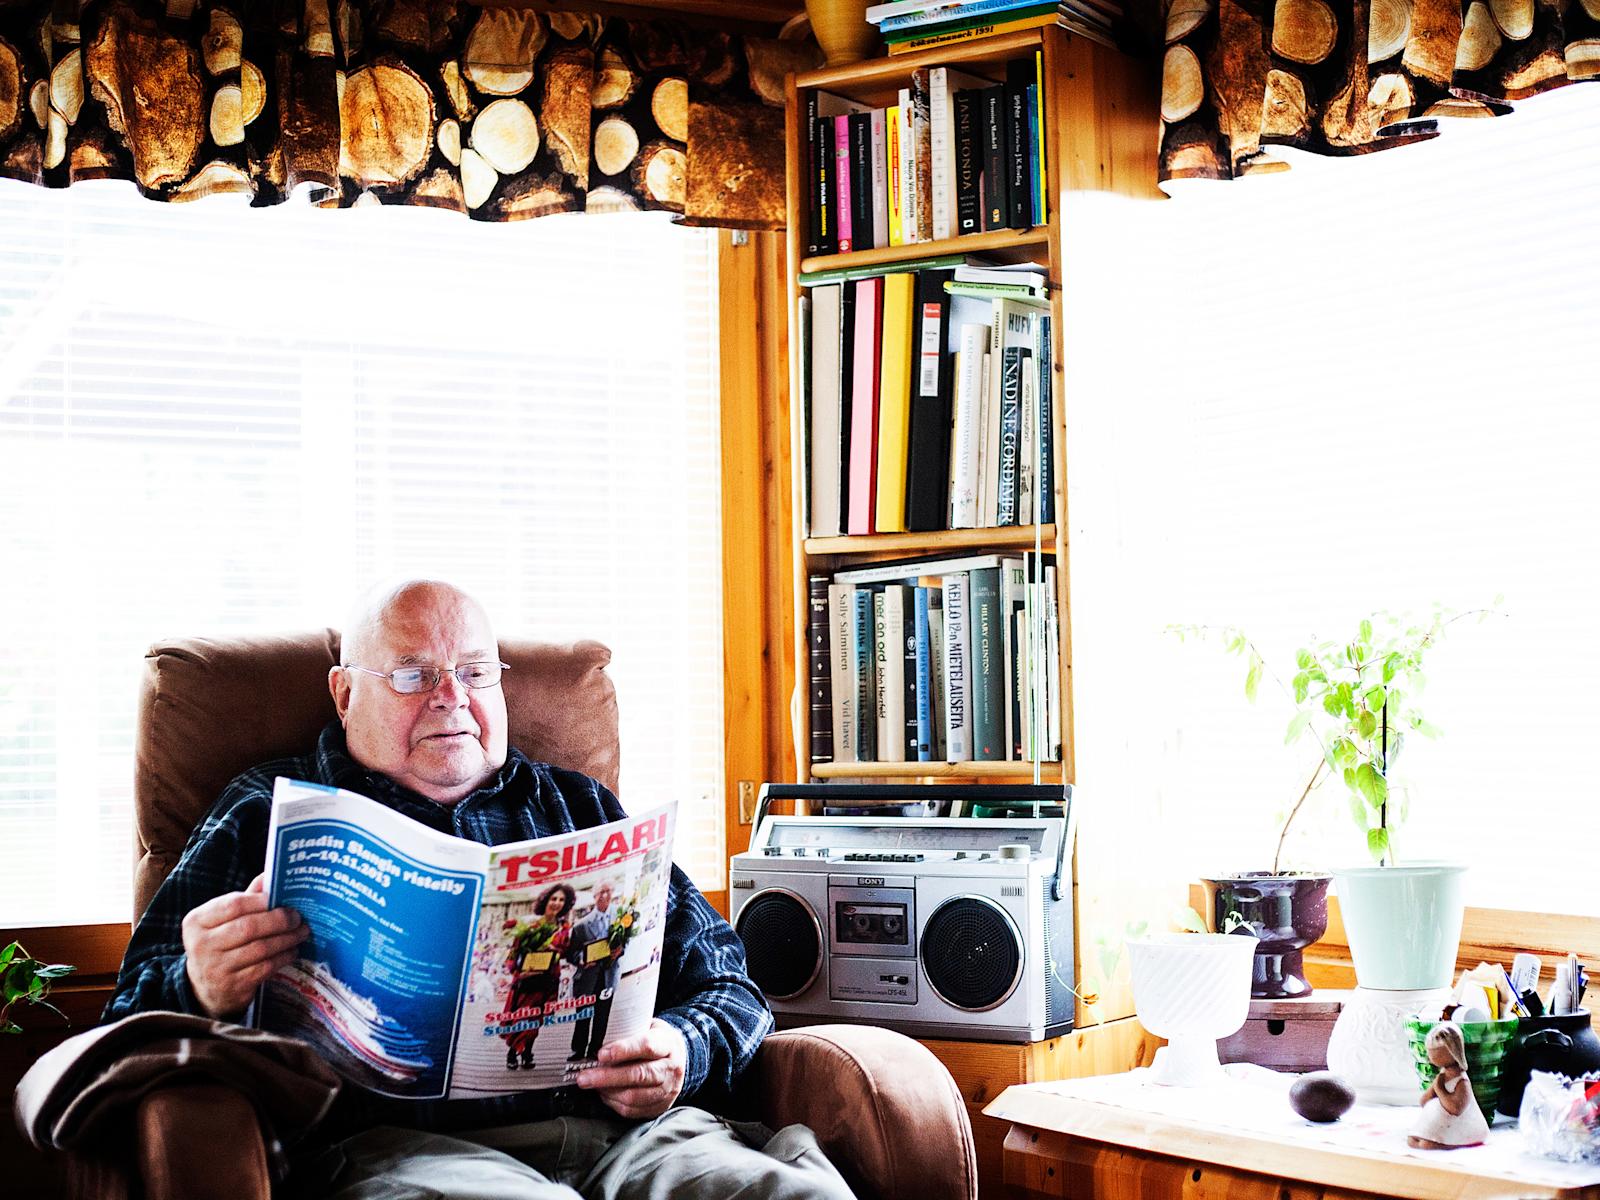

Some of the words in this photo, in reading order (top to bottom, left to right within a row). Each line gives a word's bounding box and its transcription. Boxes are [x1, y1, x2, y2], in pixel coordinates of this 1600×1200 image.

[976, 26, 994, 36] 1991
[958, 97, 968, 134] JANE
[961, 139, 972, 190] FONDA
[1003, 362, 1017, 429] NADINE
[1001, 432, 1016, 522] GORDIMER
[839, 593, 848, 618] Sally
[876, 595, 885, 618] mer
[948, 584, 961, 619] KELLO
[839, 621, 849, 670] Salminen
[878, 622, 887, 638] än
[949, 622, 961, 640] 12:n
[878, 642, 887, 661] ord
[982, 639, 990, 674] CLINTON
[878, 667, 886, 685] John
[950, 643, 964, 730] MIETELAUSEITA
[842, 699, 850, 717] Vid
[878, 687, 886, 718] Herzfeld
[843, 721, 851, 749] havet
[288, 836, 344, 852] Stadin
[348, 840, 400, 878] Slangin
[500, 813, 668, 883] TSILARI
[286, 866, 331, 876] VIKING
[484, 1020, 540, 1036] Stadin
[542, 1006, 595, 1028] Kundi
[485, 1006, 540, 1024] Stadin
[543, 994, 597, 1014] Friidu
[599, 988, 614, 1000] &
